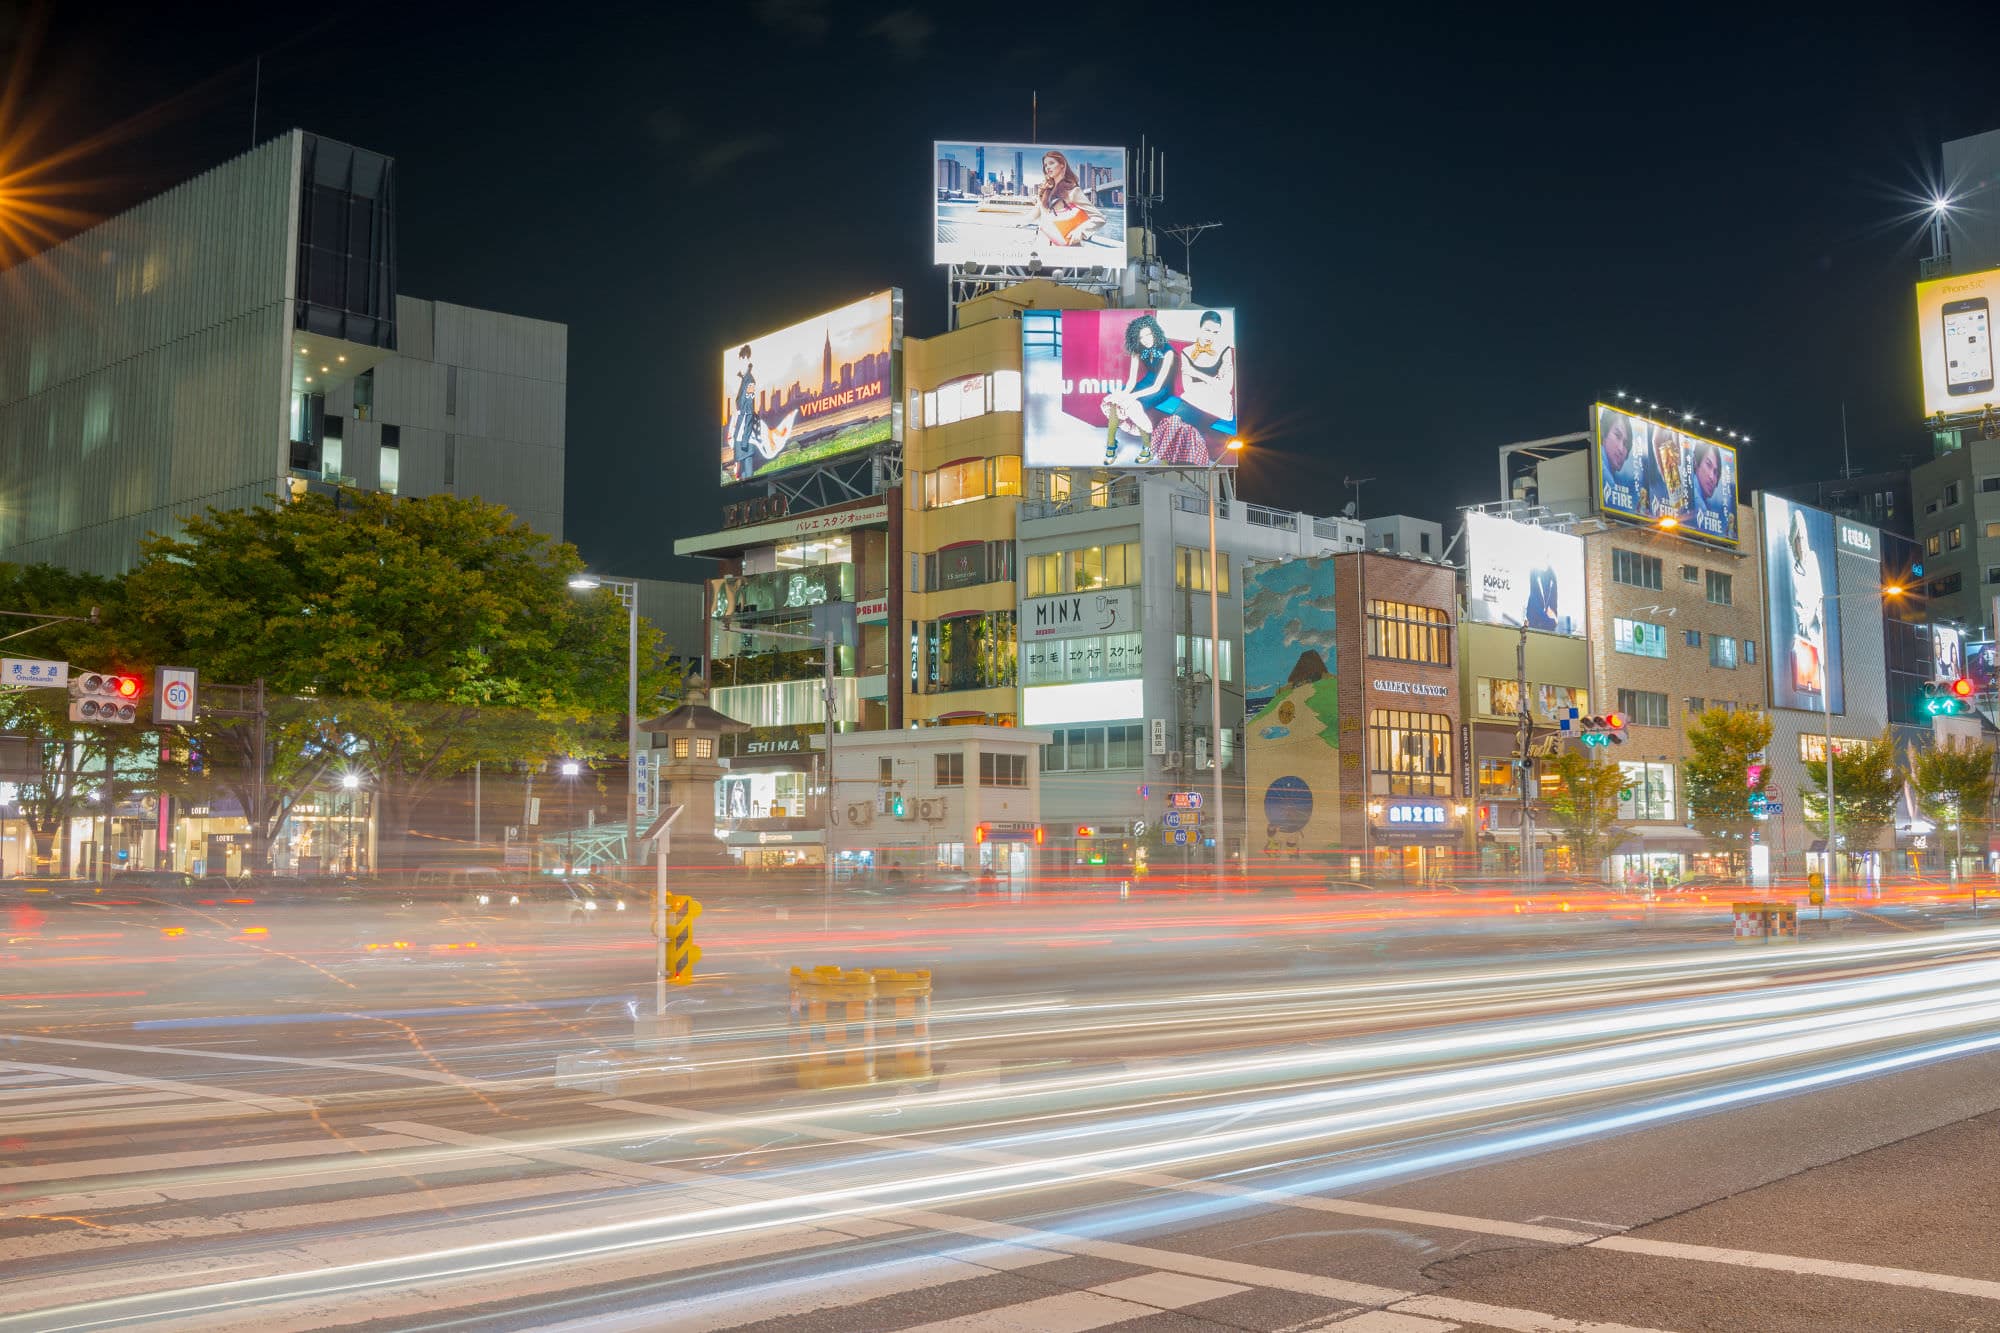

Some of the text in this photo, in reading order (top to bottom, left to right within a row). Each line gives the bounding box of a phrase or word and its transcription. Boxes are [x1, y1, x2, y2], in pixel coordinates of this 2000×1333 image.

[800, 381, 881, 416] VIVIENNE TAM
[1611, 490, 1633, 509] FIRE
[796, 519, 820, 531] バレエ
[823, 512, 856, 528] スタジオ
[1704, 516, 1723, 533] FIRE
[1036, 598, 1081, 626] MINX
[1029, 644, 1143, 665] まつ毛 エクステ スクール
[12, 663, 58, 677] 表参道
[1373, 679, 1411, 694] GALLERY
[169, 688, 187, 703] 50
[747, 740, 800, 753] SHIMA
[1175, 832, 1186, 842] 413
